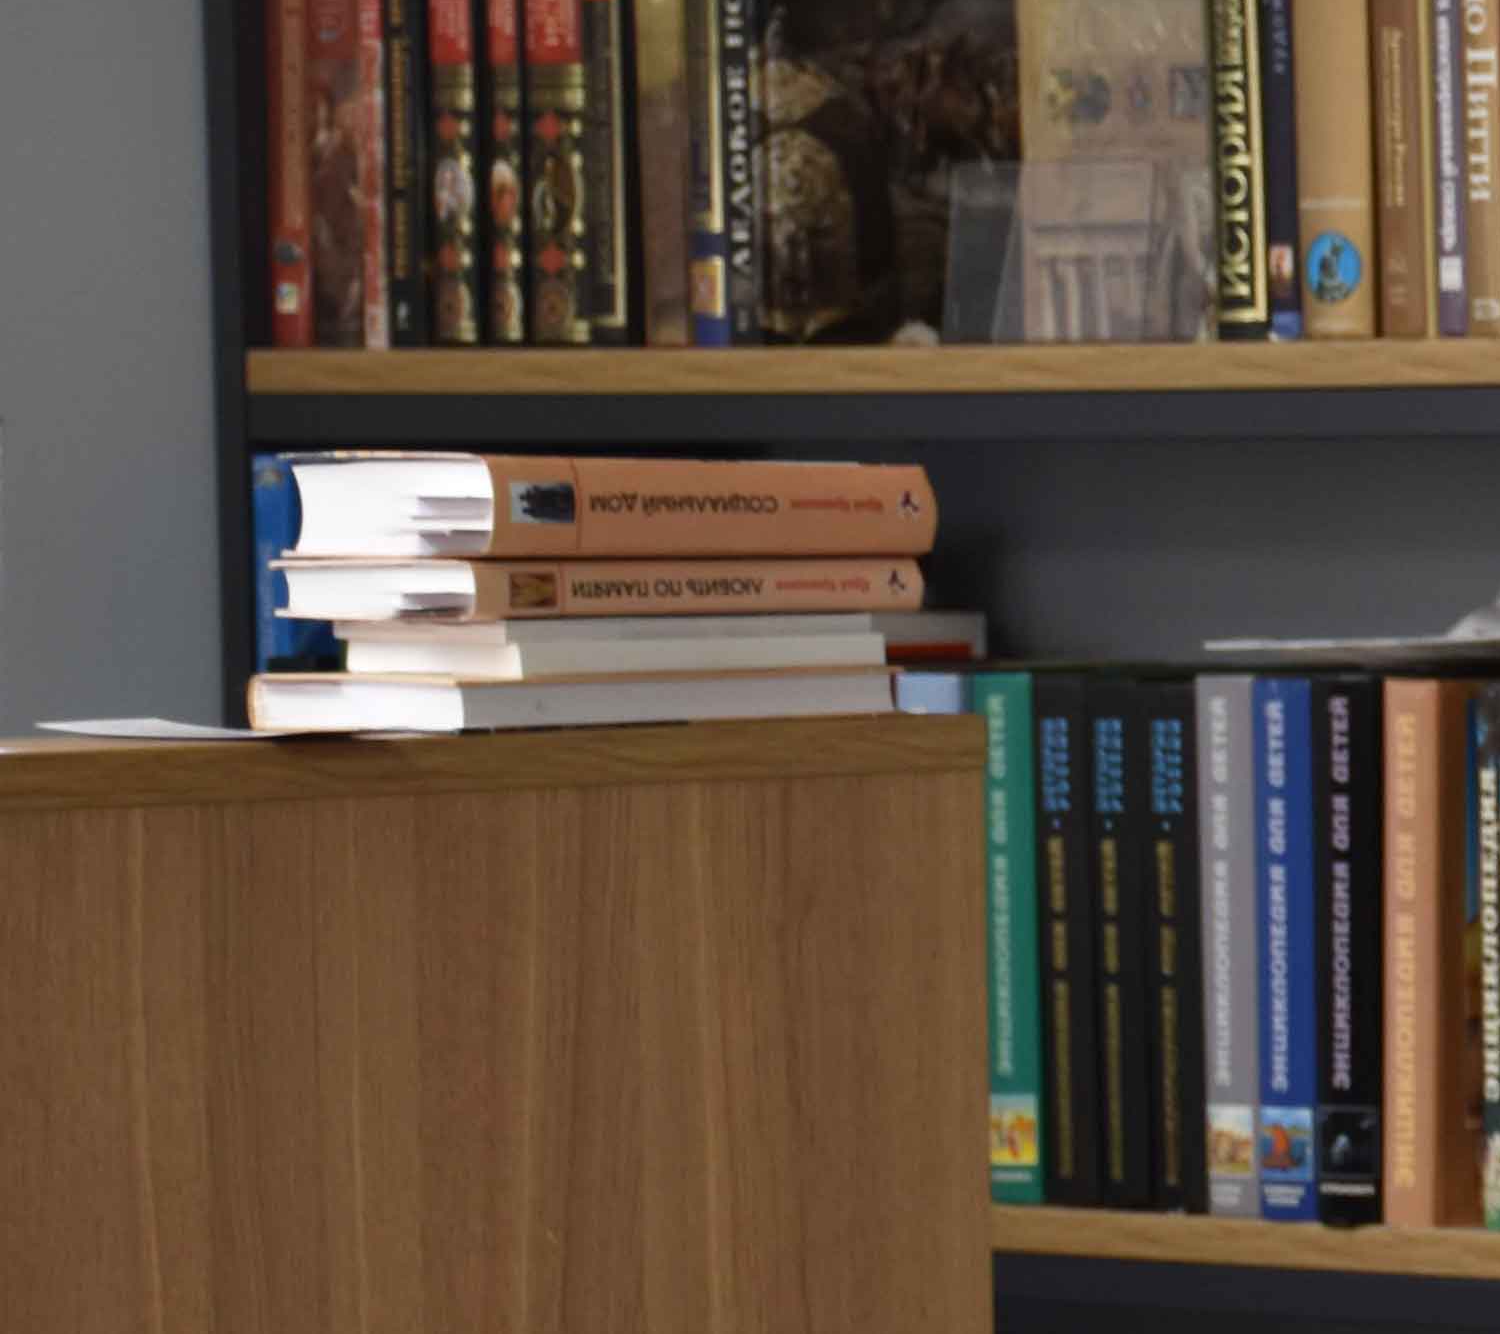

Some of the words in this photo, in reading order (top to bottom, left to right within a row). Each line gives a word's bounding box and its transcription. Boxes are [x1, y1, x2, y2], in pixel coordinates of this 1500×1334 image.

[725, 64, 754, 275] ЛЕДОВОЕ
[589, 492, 638, 512] ДОМ
[640, 493, 779, 516] СОЦИАЛЬНЫЙ
[571, 579, 650, 599] ПАМЯТИ
[655, 578, 683, 597] ПО
[685, 577, 764, 596] ЛЮБИТЬ
[985, 694, 1006, 780] ДЕТЕЙ
[1207, 695, 1228, 784] ДЕТЕЙ
[1263, 699, 1285, 788] ДЕТЕЙ
[1325, 695, 1349, 785] ДЕТЕЙ
[1390, 714, 1416, 821] ДЕТЕЙ
[989, 787, 1008, 844] ДЛЯ
[1211, 791, 1230, 851] ДЛЯ
[1268, 798, 1286, 855] ДЛЯ
[1331, 794, 1350, 852] ДЛЯ
[1394, 832, 1416, 900] ДЛЯ
[993, 854, 1015, 1077] ЭНЦИКЛОПЕДИЯ
[1212, 860, 1233, 1087] ЭНЦИКЛОПЕДИЯ
[1268, 862, 1290, 1093] ЭНЦИКЛОПЕДИЯ
[1329, 861, 1352, 1091] ЭНЦИКЛОПЕДИЯ
[1479, 767, 1500, 1104] ЭНЦИКЛОПЕДИЯ
[1393, 911, 1418, 1188] ЭНЦИКЛОПЕДИЯ
